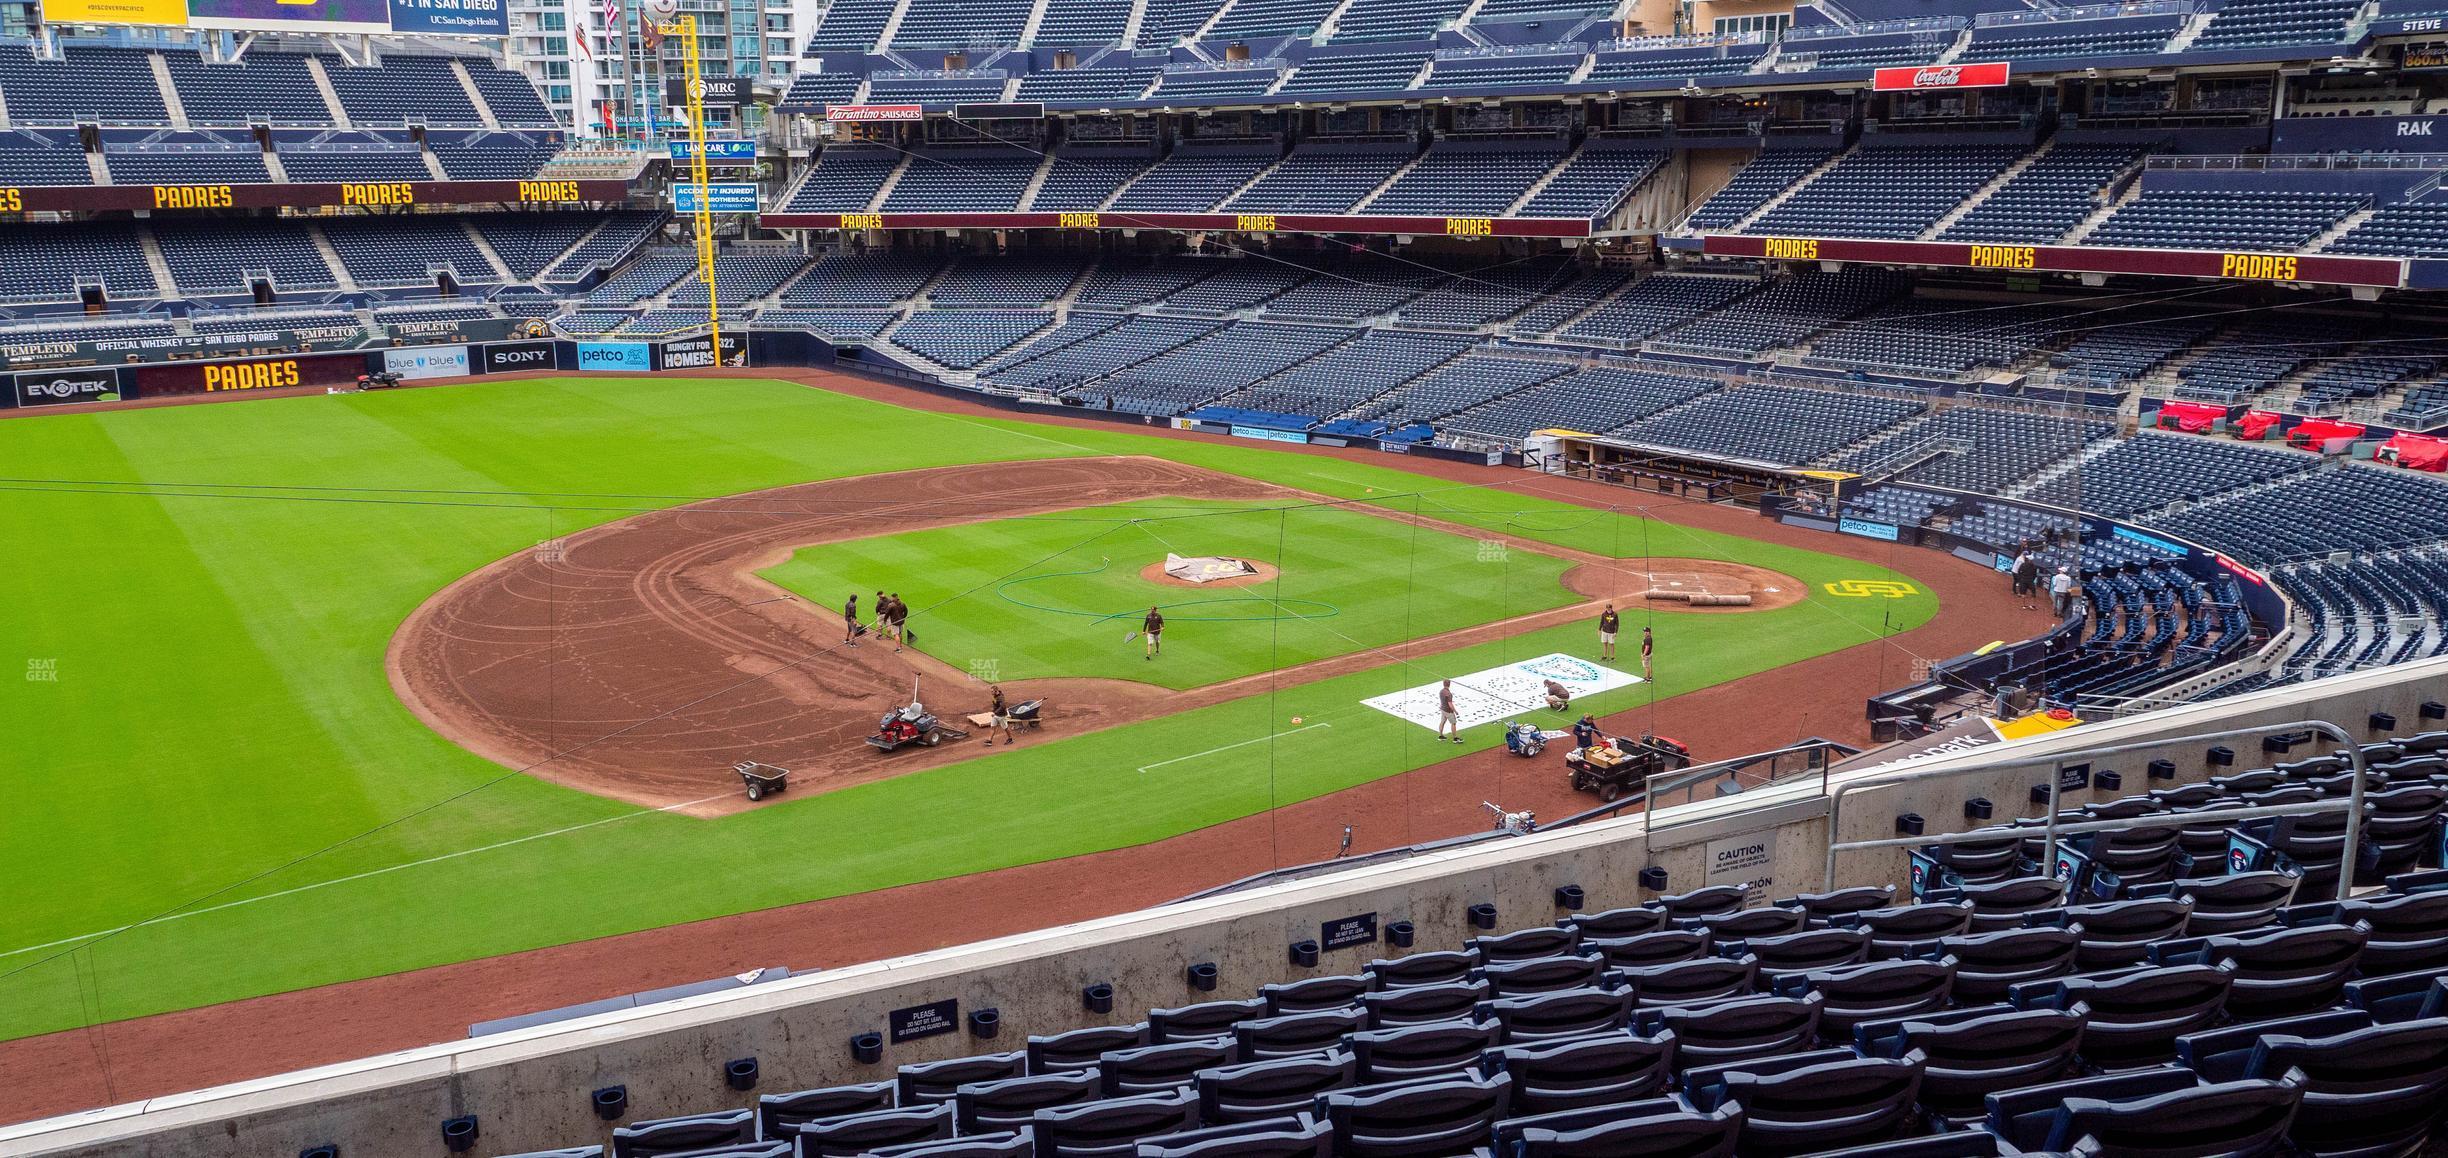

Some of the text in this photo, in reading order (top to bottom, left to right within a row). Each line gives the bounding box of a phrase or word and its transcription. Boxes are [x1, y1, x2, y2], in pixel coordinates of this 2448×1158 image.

[419, 0, 431, 8] IN
[435, 0, 459, 9] SAN
[463, 0, 497, 10] DIEGO
[443, 16, 456, 25] San
[457, 17, 476, 26] Diego
[477, 18, 499, 26] Health
[2402, 20, 2442, 31] STEVE
[1913, 67, 1962, 86] Coca-Cola
[708, 82, 736, 93] MRC
[829, 108, 920, 119] Tarantino SAUSAGES
[2397, 121, 2433, 136] RAK
[685, 144, 725, 152] LANCARE
[341, 183, 413, 205] PADRES
[518, 180, 579, 201] PADRES
[720, 187, 755, 195] INJURED?
[153, 186, 233, 209] PADRES
[841, 214, 882, 228] PADRES
[1060, 213, 1099, 227] PADRES
[1237, 215, 1275, 230] PADRES
[1447, 219, 1491, 235] PADRES
[1766, 239, 1818, 259] PADRES
[1971, 246, 2035, 268] PADRES
[2222, 254, 2297, 280] PADRES
[294, 328, 358, 340] TEMPLETON
[398, 321, 459, 334] TEMPLETON
[96, 340, 140, 351] OFFICIAL
[140, 338, 183, 349] WHISKEY
[205, 335, 222, 345] SAN
[224, 334, 247, 344] DIEGO
[248, 332, 279, 342] PADRES
[667, 341, 711, 352] HUNGRY FOR
[719, 337, 735, 349] 322
[2, 343, 77, 358] TEMPLETON
[582, 348, 624, 364] petco
[388, 359, 414, 369] blue
[429, 356, 454, 366] blue
[495, 351, 547, 364] SONY
[665, 351, 715, 367] HOMERS
[204, 360, 299, 392] PADRES
[1232, 426, 1250, 436] petco
[1269, 430, 1288, 440] petco
[1841, 520, 1868, 532] petco
[1718, 844, 1764, 861] CAUTION
[913, 1009, 935, 1020] PLEASE
[906, 1026, 919, 1034] STAND
[927, 1022, 941, 1030] GUARD
